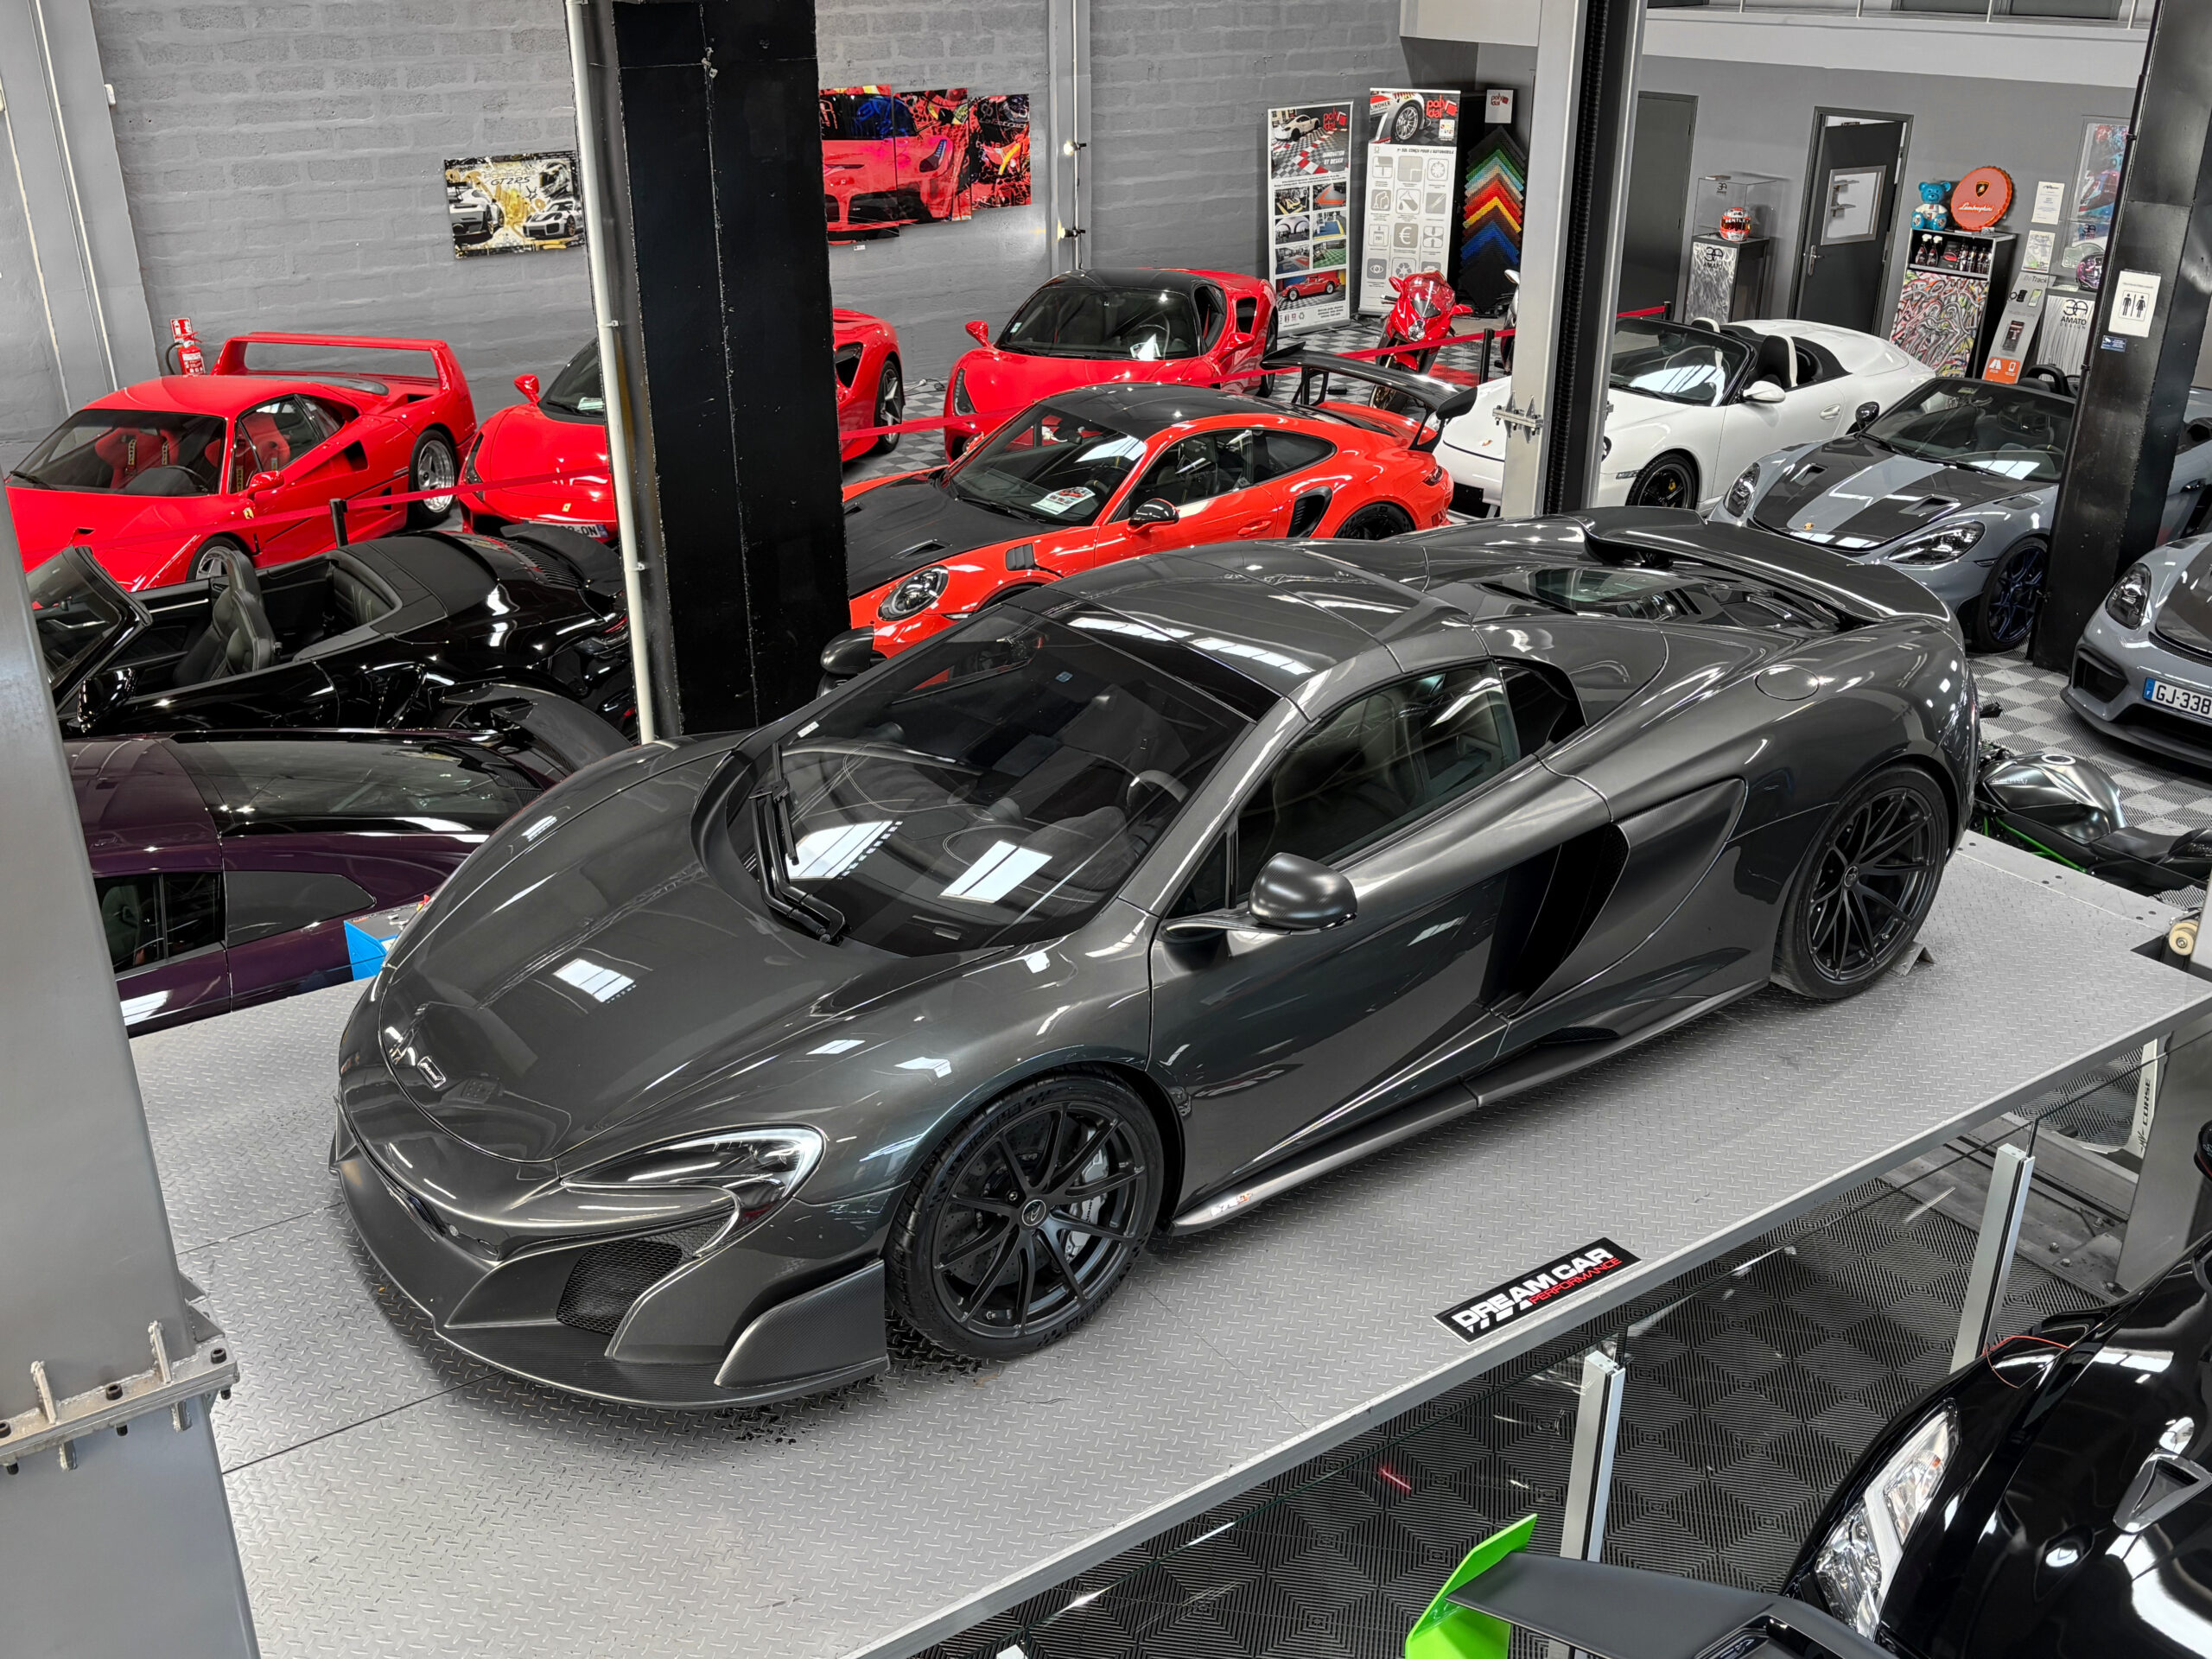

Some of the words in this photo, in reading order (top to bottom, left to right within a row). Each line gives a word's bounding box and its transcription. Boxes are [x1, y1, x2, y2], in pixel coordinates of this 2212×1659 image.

[2060, 315, 2087, 326] AMATO
[2142, 1077, 2152, 1127] CORSE
[1452, 1273, 1558, 1329] DREAM
[1552, 1248, 1614, 1280] CAR
[1529, 1257, 1623, 1305] PERFORMANCE
